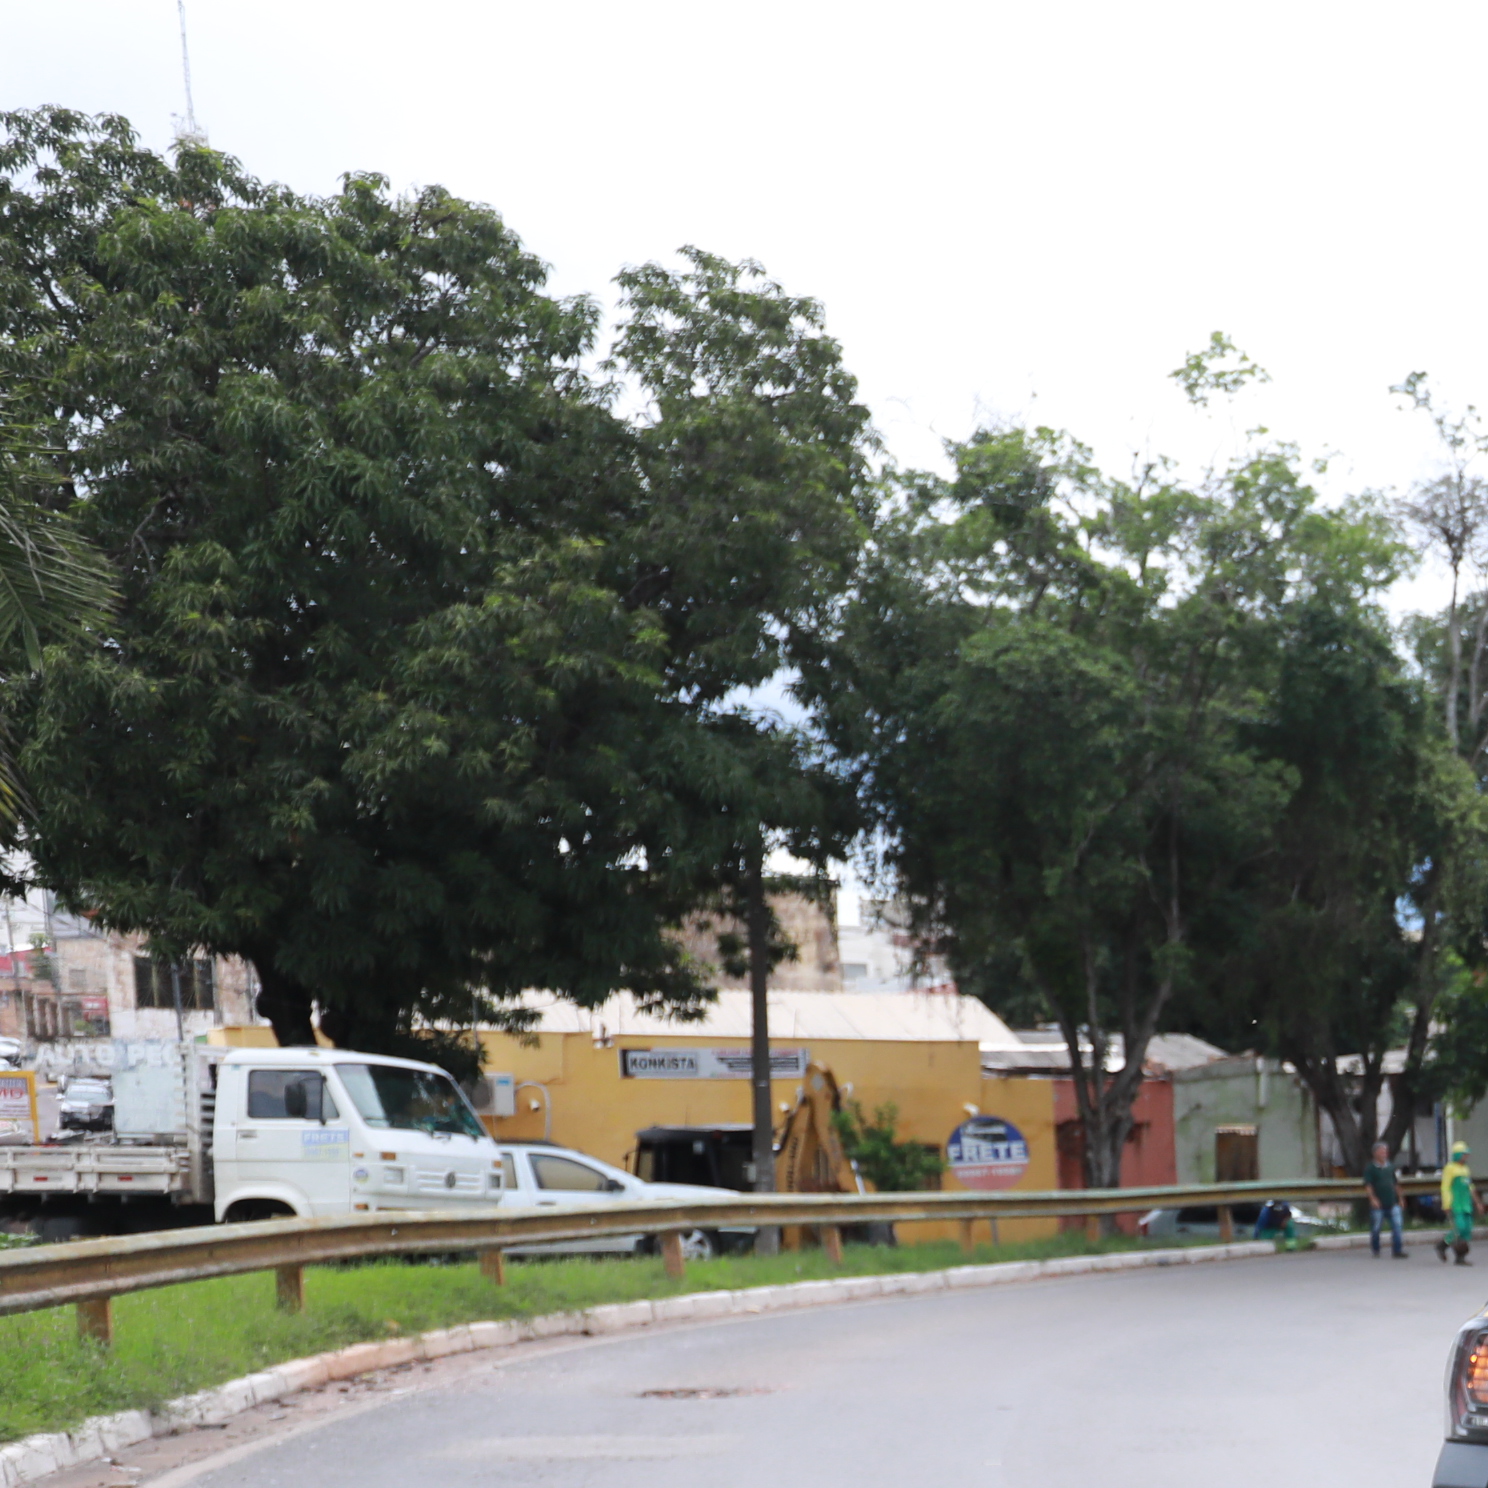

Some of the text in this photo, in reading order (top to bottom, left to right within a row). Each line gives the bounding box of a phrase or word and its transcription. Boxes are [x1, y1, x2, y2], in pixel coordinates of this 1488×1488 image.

[36, 1043, 116, 1067] AUTO
[629, 1056, 696, 1071] KONKISTA
[947, 1139, 1027, 1162] FRETE
